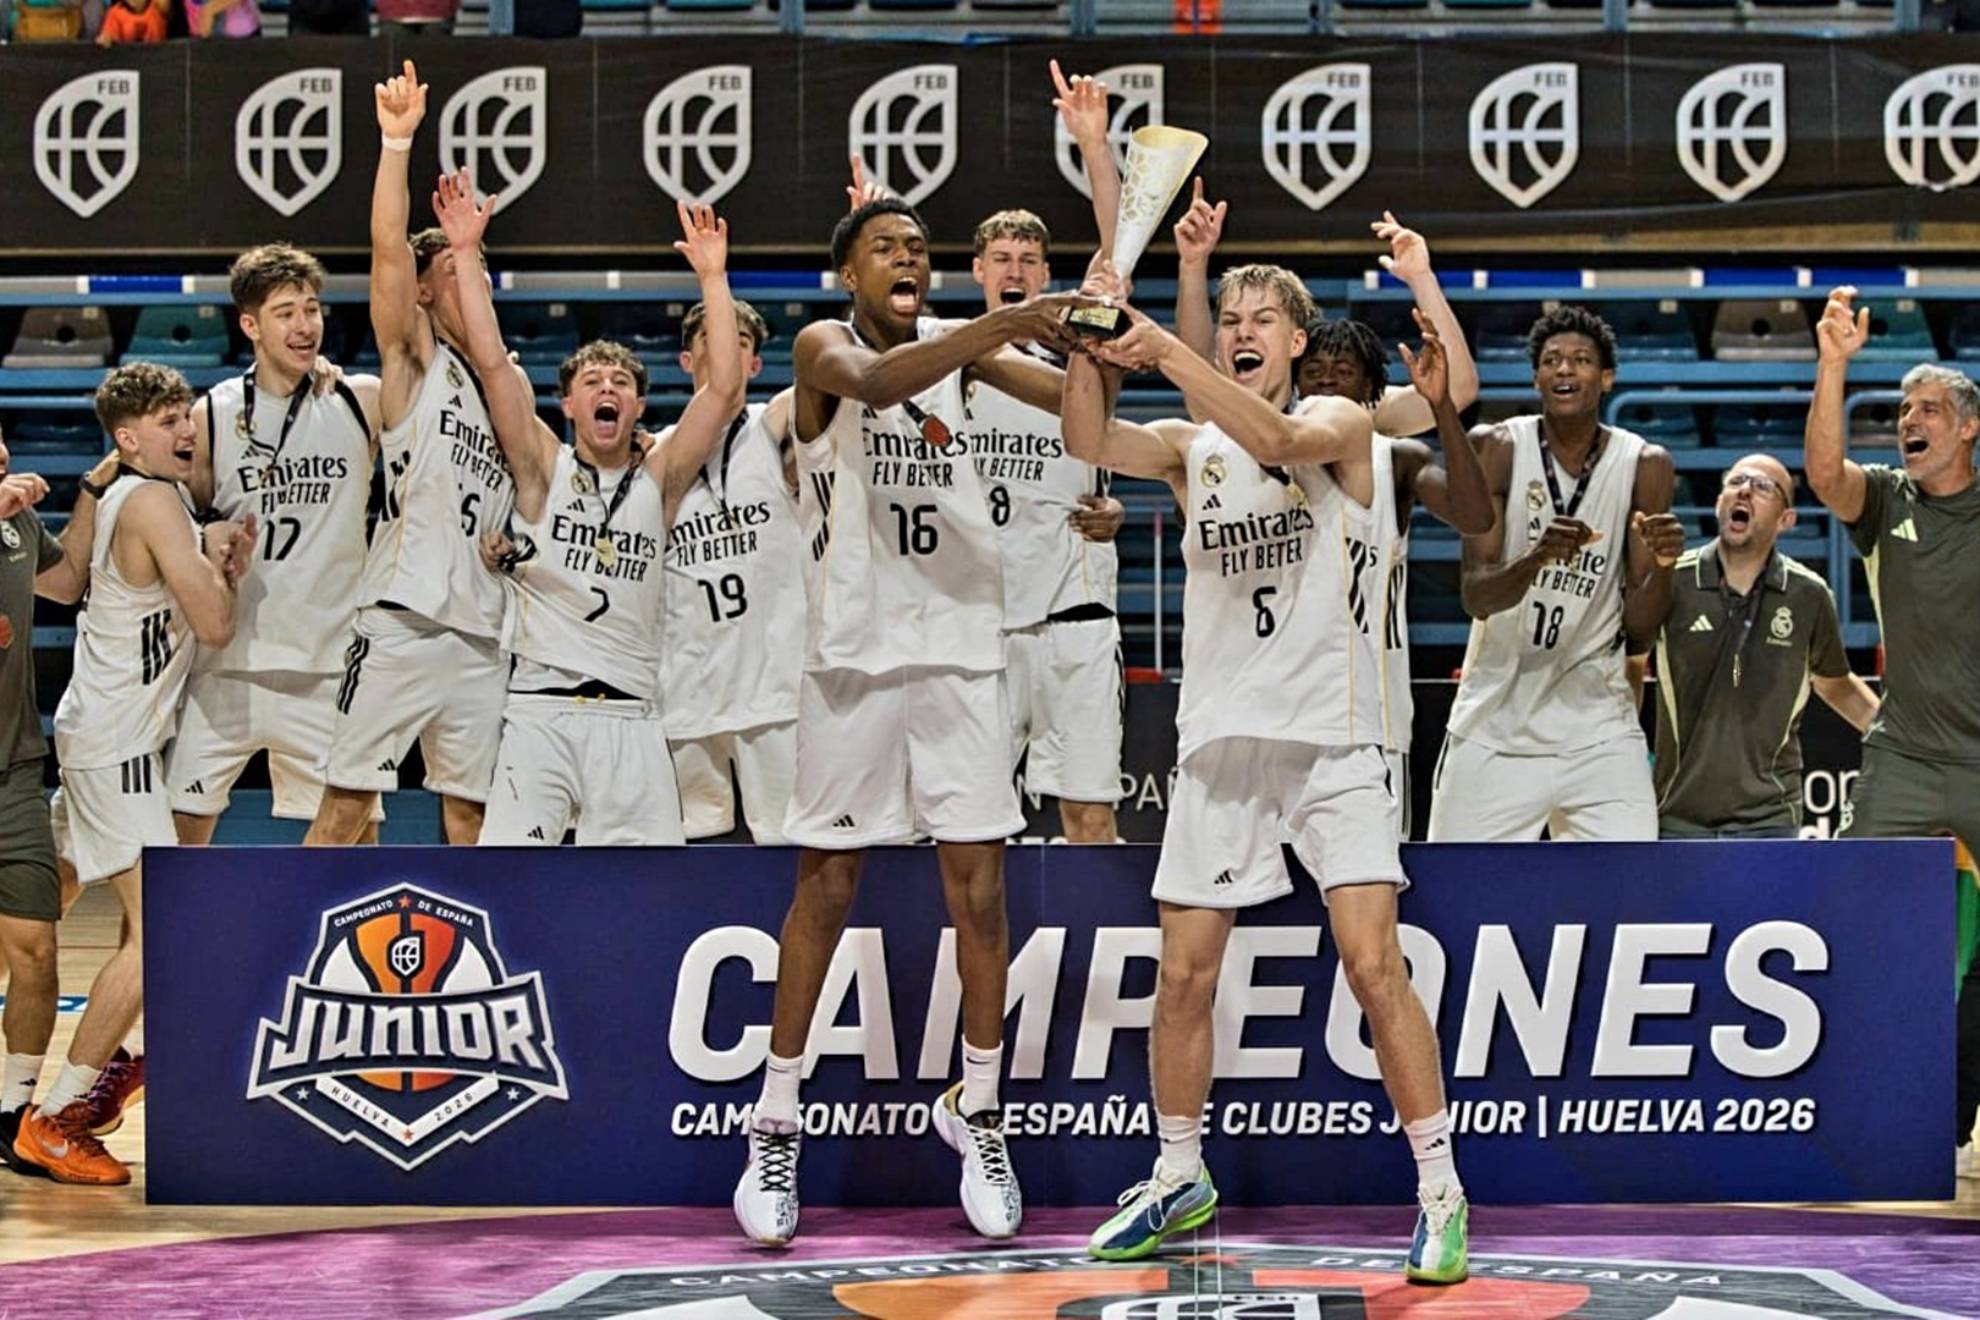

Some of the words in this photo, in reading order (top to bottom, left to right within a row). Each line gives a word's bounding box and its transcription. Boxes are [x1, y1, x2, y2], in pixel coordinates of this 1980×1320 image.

[97, 80, 130, 95] FEB
[300, 78, 332, 93] FEB
[503, 76, 536, 91] FEB
[708, 75, 741, 90] FEB
[914, 74, 947, 90] FEB
[1119, 74, 1153, 89] FEB
[1326, 73, 1360, 88] FEB
[1533, 71, 1568, 86] FEB
[1741, 71, 1774, 86] FEB
[440, 409, 513, 479] Emira
[969, 428, 1062, 458] mirates
[873, 461, 901, 486] FLY
[907, 462, 953, 487] BETER
[989, 457, 1044, 481] BETTER
[989, 486, 1010, 527] 8
[264, 517, 301, 561] 17
[552, 514, 656, 560] Emrates
[668, 501, 771, 548] mirates
[890, 503, 938, 556] 16
[565, 548, 592, 572] FLY
[677, 543, 697, 567] FLY
[703, 530, 758, 562] BETTER
[1222, 549, 1249, 577] FLY
[1256, 537, 1303, 569] BETER
[697, 573, 748, 622] 19
[1252, 586, 1278, 639] 6
[1533, 601, 1564, 650] 18
[334, 900, 393, 928] CAMPEONATO
[418, 900, 432, 912] DE
[435, 907, 474, 927] ESPAÑA
[331, 1086, 390, 1127] HUELVA
[434, 1092, 473, 1122] 2026
[670, 1102, 930, 1136] CAMONATO
[1002, 1094, 1151, 1136] ESPAÑA
[1222, 1101, 1373, 1136] CLUBES
[1379, 1100, 1526, 1135] JIOR
[1558, 1099, 1705, 1134] HUELVA
[1712, 1098, 1816, 1133] 2026
